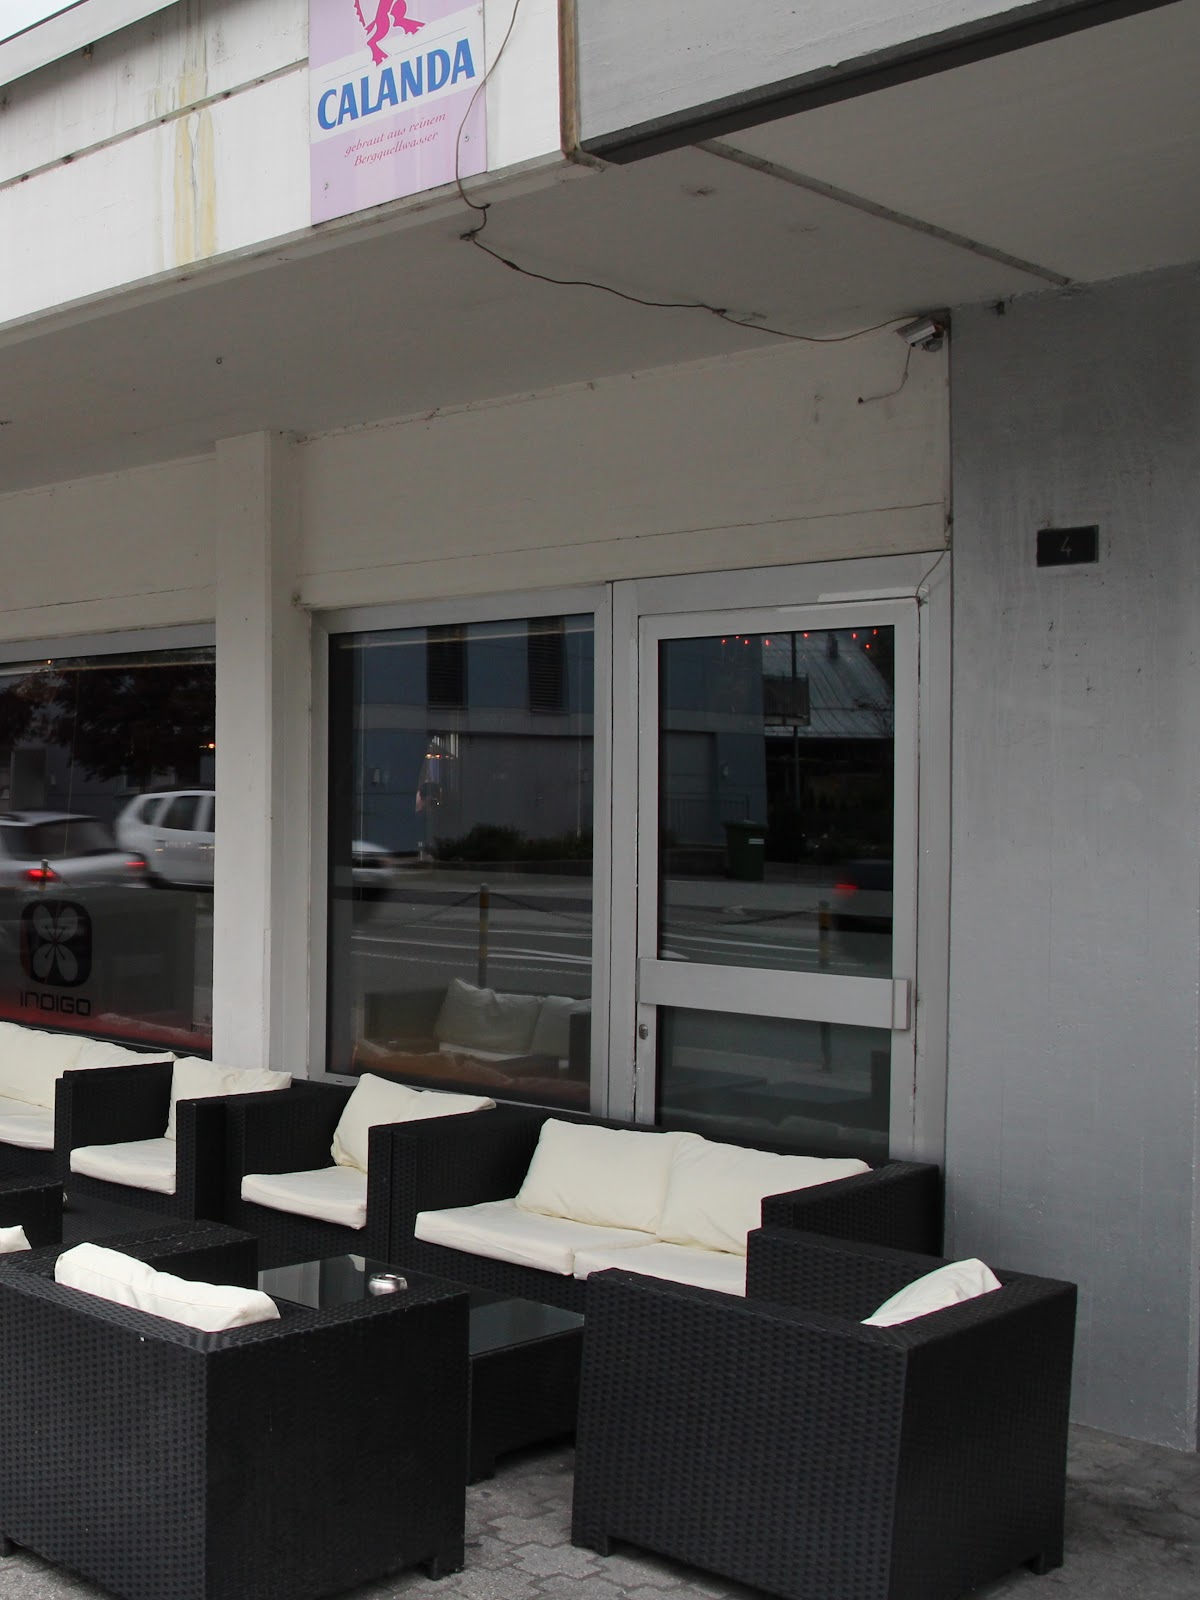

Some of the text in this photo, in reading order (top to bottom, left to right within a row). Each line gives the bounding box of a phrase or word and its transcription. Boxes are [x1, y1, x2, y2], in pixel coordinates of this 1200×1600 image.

[317, 38, 476, 130] CALANDA
[344, 113, 447, 157] gebraut aus reinem
[353, 131, 439, 167] Bergquellwasser
[1060, 536, 1072, 558] 4
[20, 992, 92, 1017] INDIGO
